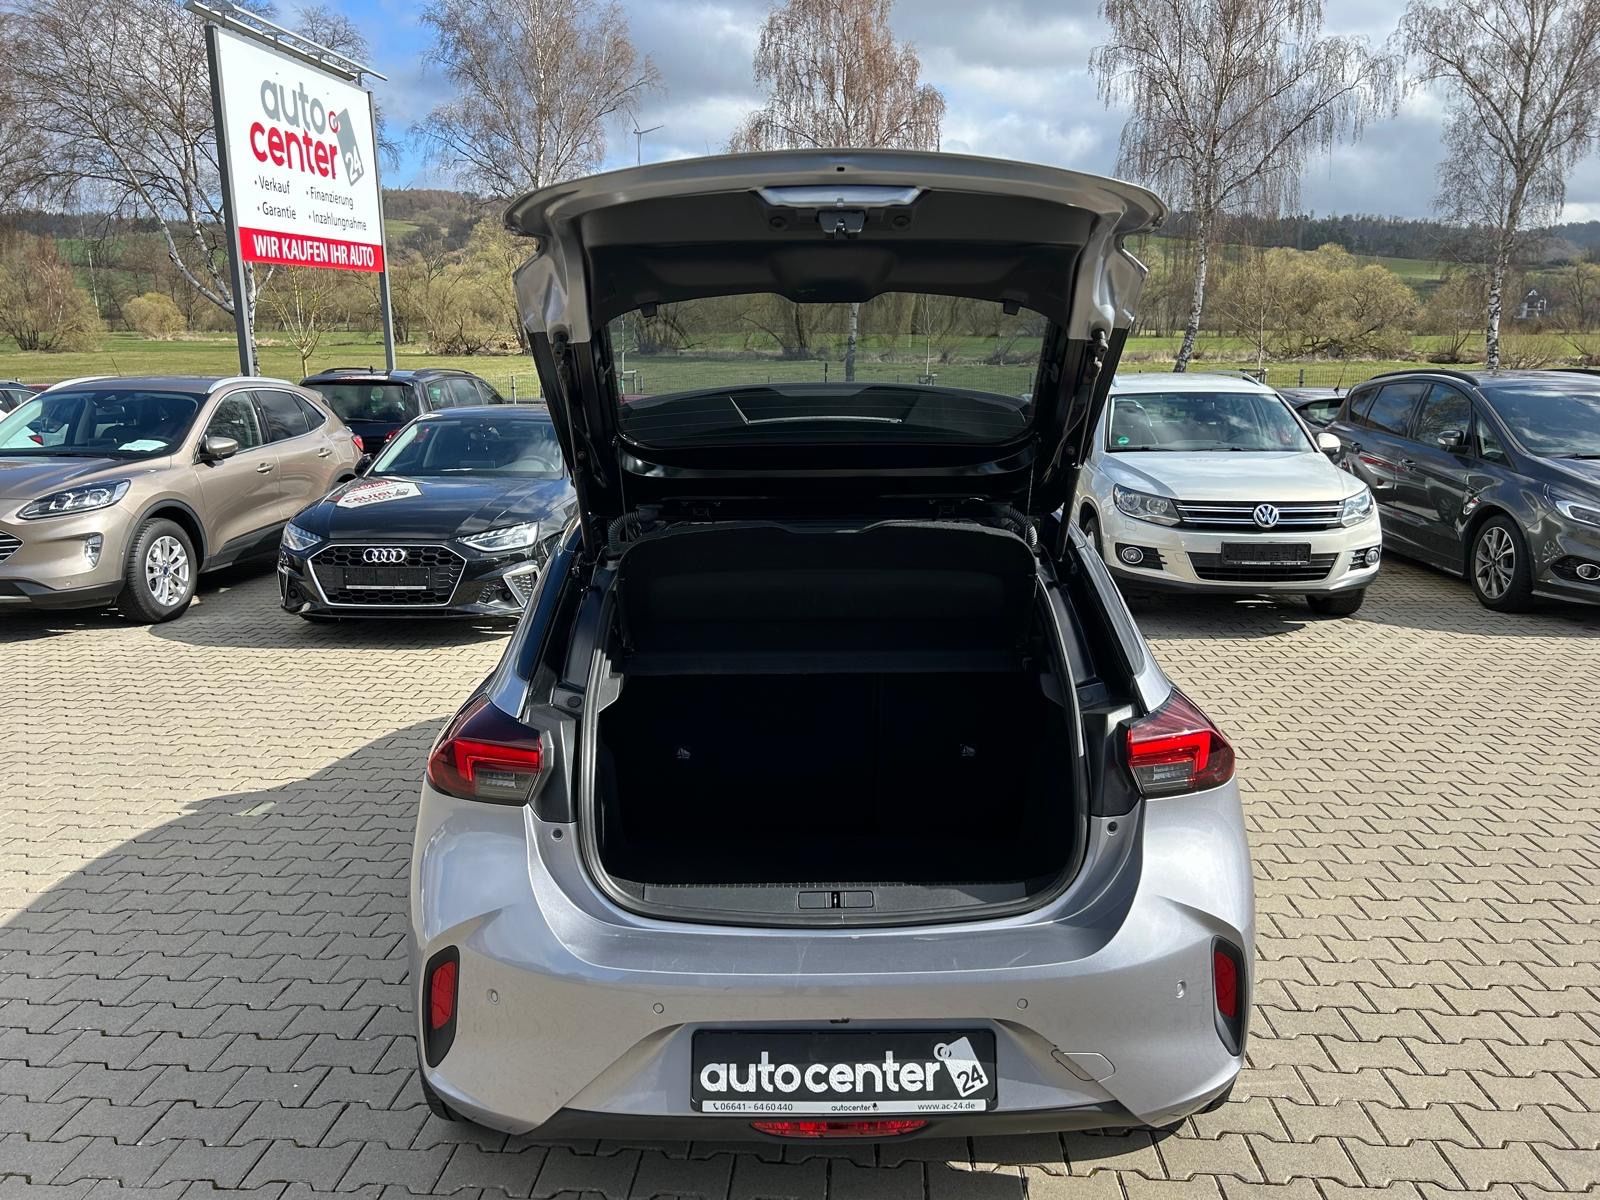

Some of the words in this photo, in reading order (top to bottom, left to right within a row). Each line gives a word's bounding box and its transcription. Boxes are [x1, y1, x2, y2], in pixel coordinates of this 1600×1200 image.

[260, 79, 326, 135] auto
[250, 121, 338, 180] center
[345, 146, 362, 182] 24
[259, 175, 290, 195] Verkauf
[310, 186, 354, 210] Finanzierung
[262, 201, 297, 220] Garantie
[312, 210, 367, 231] Inzahlungnahme
[253, 234, 280, 259] WIR
[281, 238, 329, 263] KAUFEN
[330, 243, 349, 265] IHR
[350, 245, 375, 267] AUTO
[700, 1051, 801, 1093] auto
[804, 1050, 940, 1093] center
[956, 1064, 984, 1093] 24
[720, 1102, 746, 1111] 06641
[831, 1103, 871, 1112] autocenter
[917, 1101, 976, 1111] www.ac-24.de
